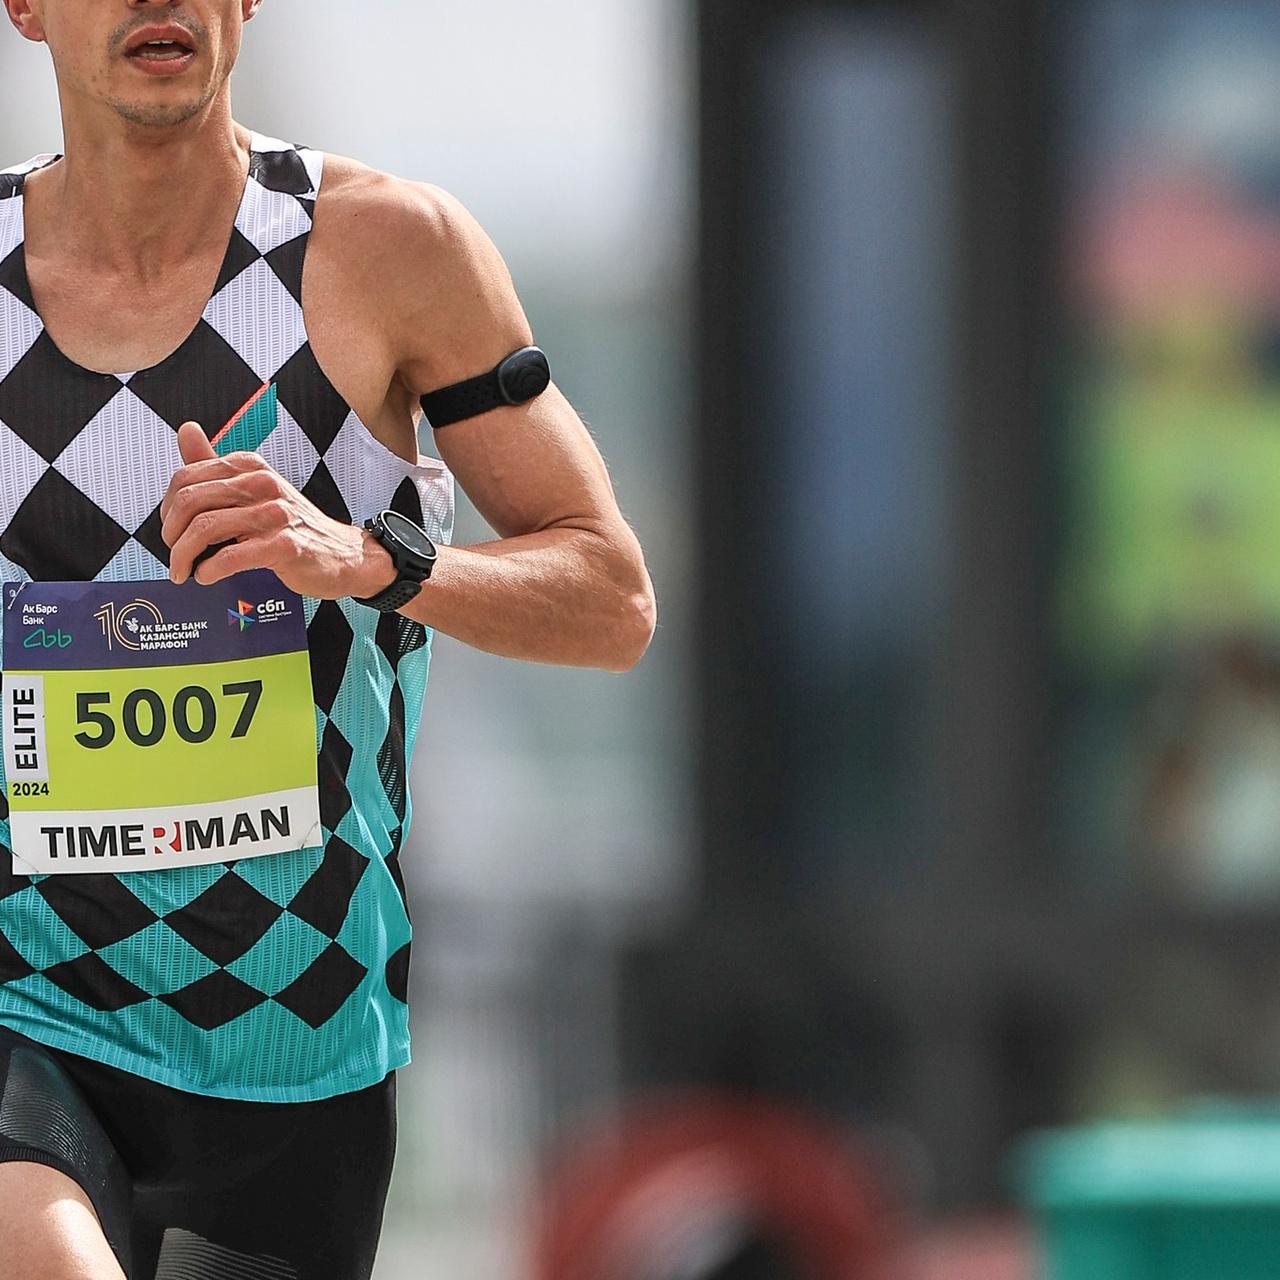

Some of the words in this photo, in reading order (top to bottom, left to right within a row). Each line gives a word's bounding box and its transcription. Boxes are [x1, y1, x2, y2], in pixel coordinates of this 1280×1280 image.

[22, 604, 35, 613] Ак
[35, 604, 58, 615] Барс
[22, 615, 45, 625] Банк
[140, 625, 153, 633] АК
[155, 623, 180, 632] БАРС
[181, 621, 208, 631] БАНК
[140, 629, 200, 642] КАЗАНСКИЙ
[140, 640, 188, 651] МАРАФОН
[74, 679, 264, 750] 5007
[12, 687, 39, 771] ELITE
[12, 782, 50, 796] 2024
